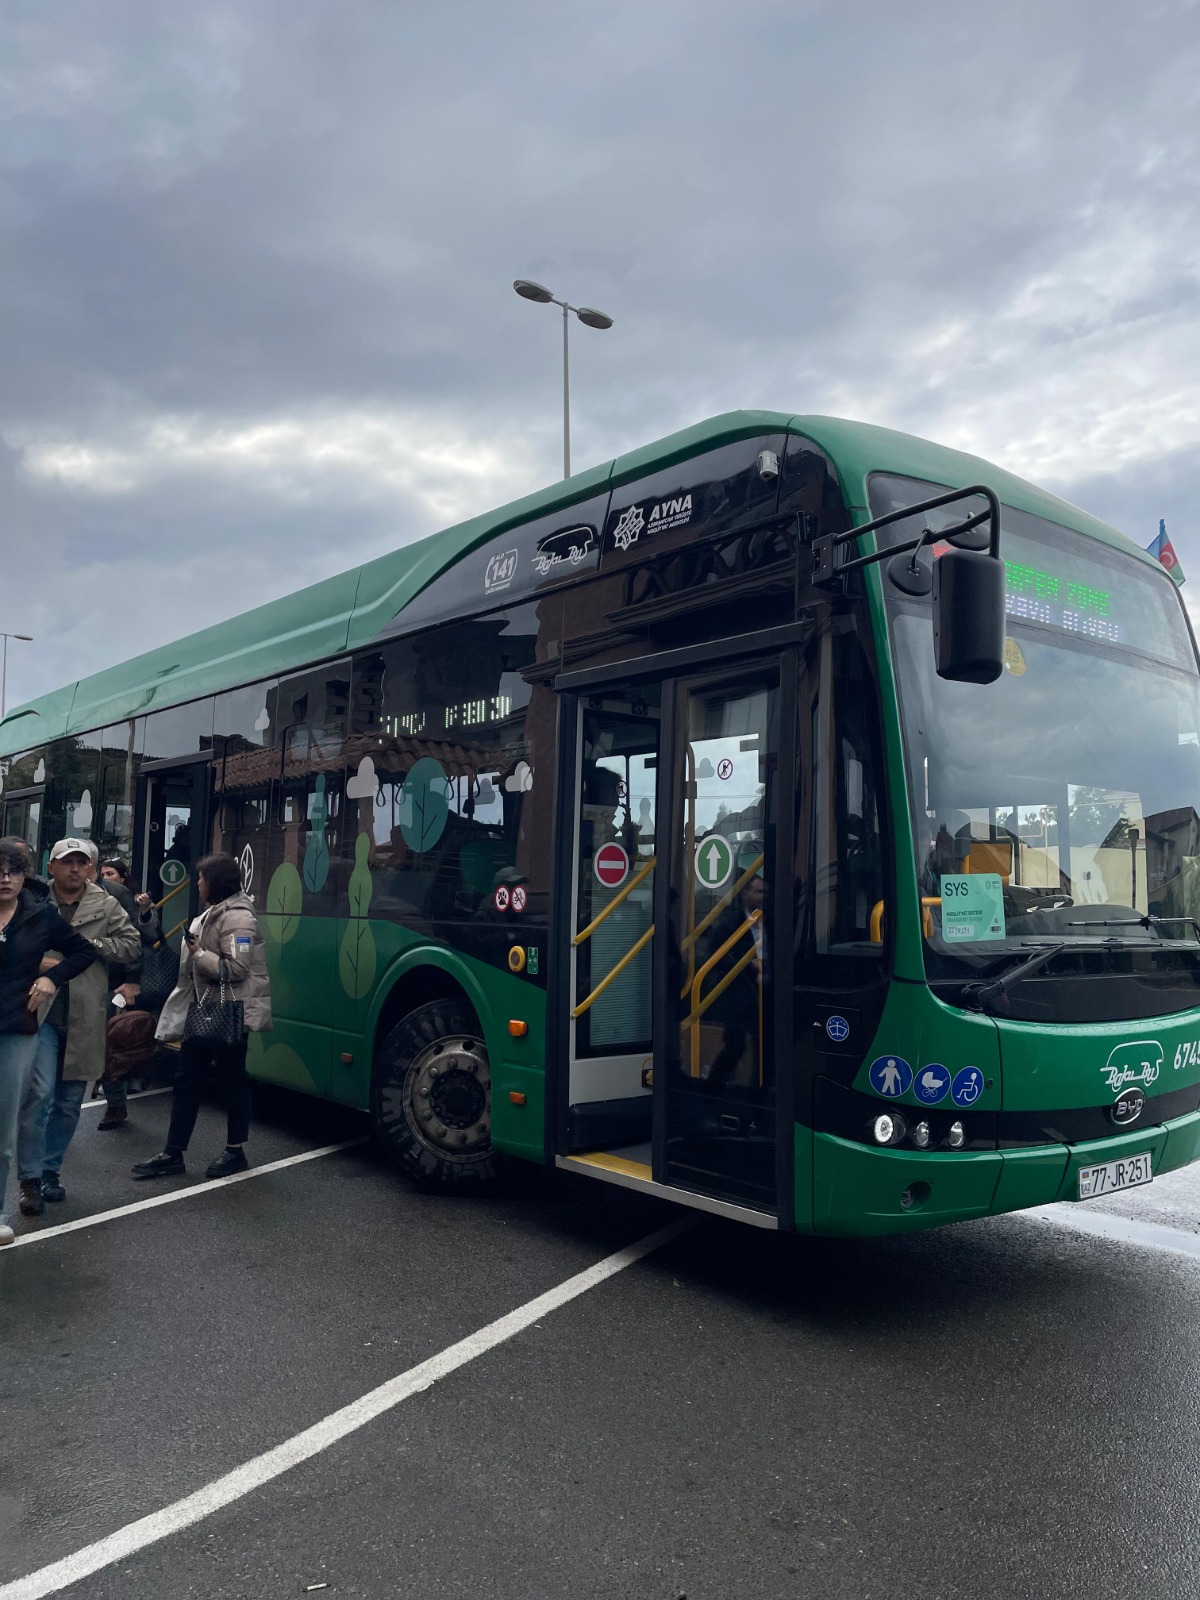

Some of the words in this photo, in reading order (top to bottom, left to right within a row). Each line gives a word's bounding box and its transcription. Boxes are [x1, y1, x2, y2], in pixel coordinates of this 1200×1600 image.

[649, 494, 692, 521] AYNA
[492, 556, 514, 581] 141
[944, 882, 969, 897] SYS
[1116, 1098, 1144, 1117] BYD
